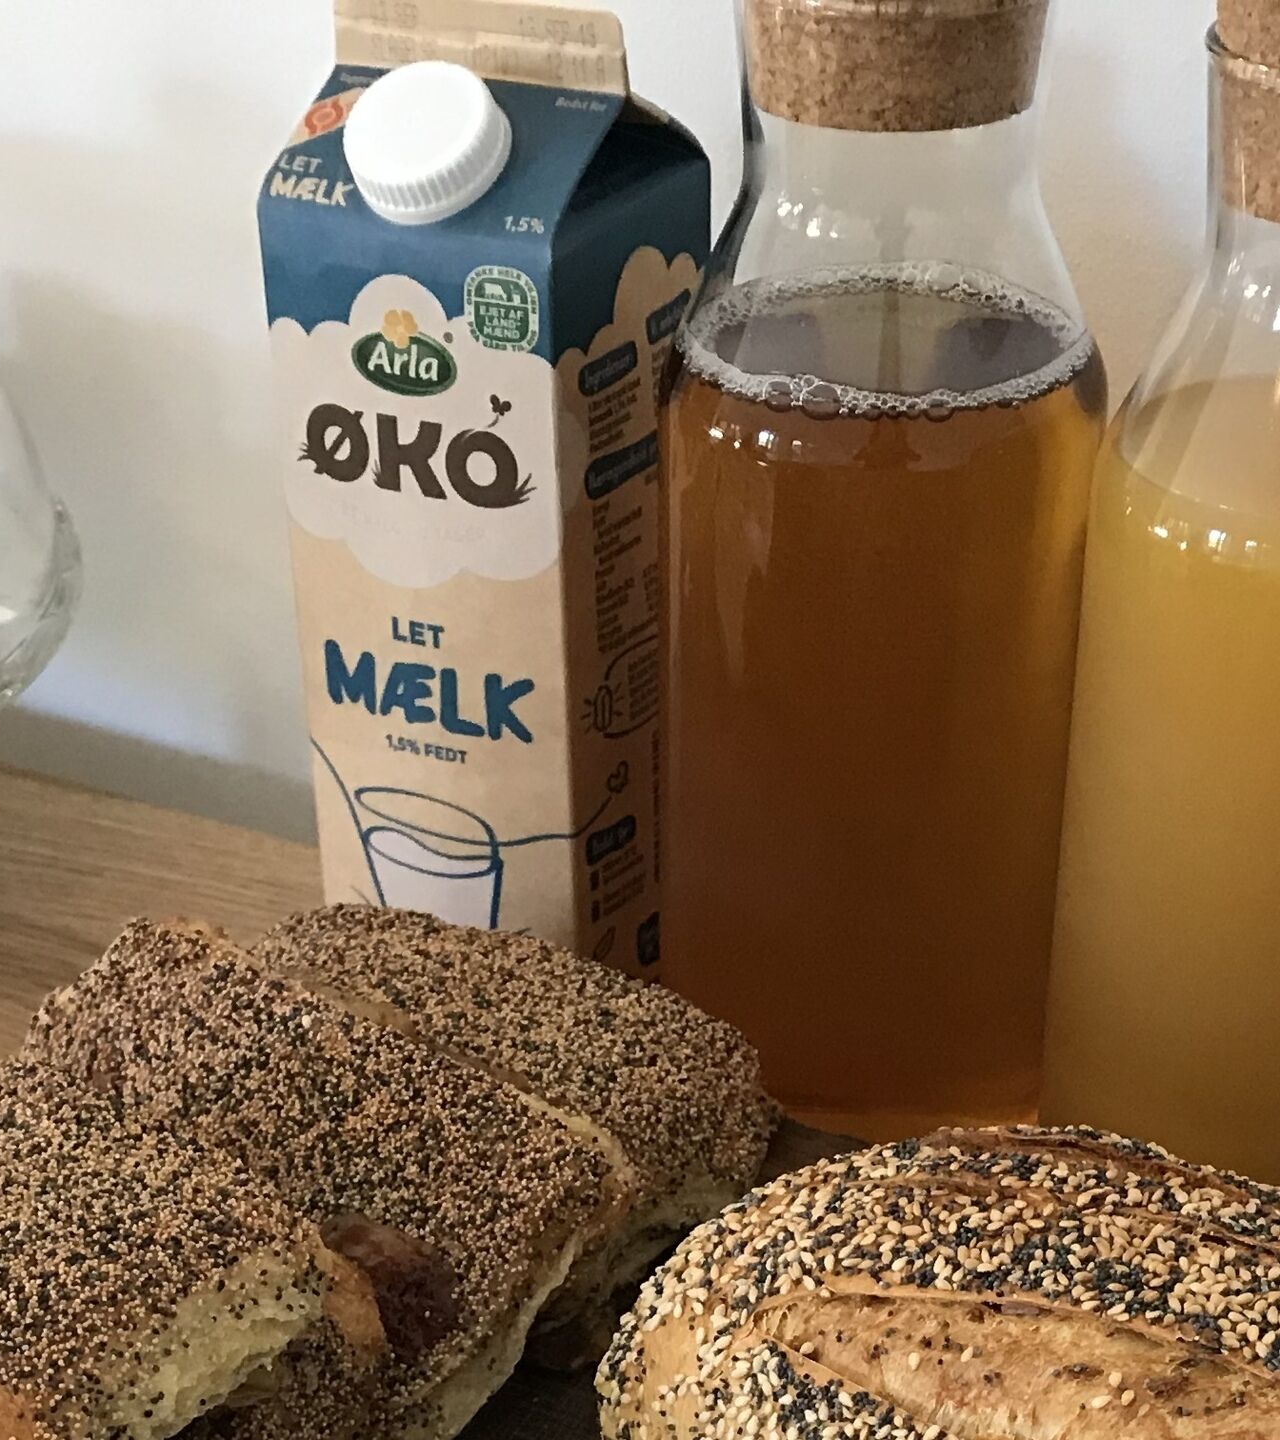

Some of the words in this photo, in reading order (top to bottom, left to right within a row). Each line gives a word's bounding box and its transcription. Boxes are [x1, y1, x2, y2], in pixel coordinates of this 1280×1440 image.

[278, 153, 322, 174] LET
[269, 171, 354, 207] MÆLK
[367, 341, 440, 382] Arla
[304, 402, 525, 509] ØKO
[391, 615, 445, 649] LET
[323, 639, 535, 744] MÆLK
[424, 741, 468, 765] FEDT
